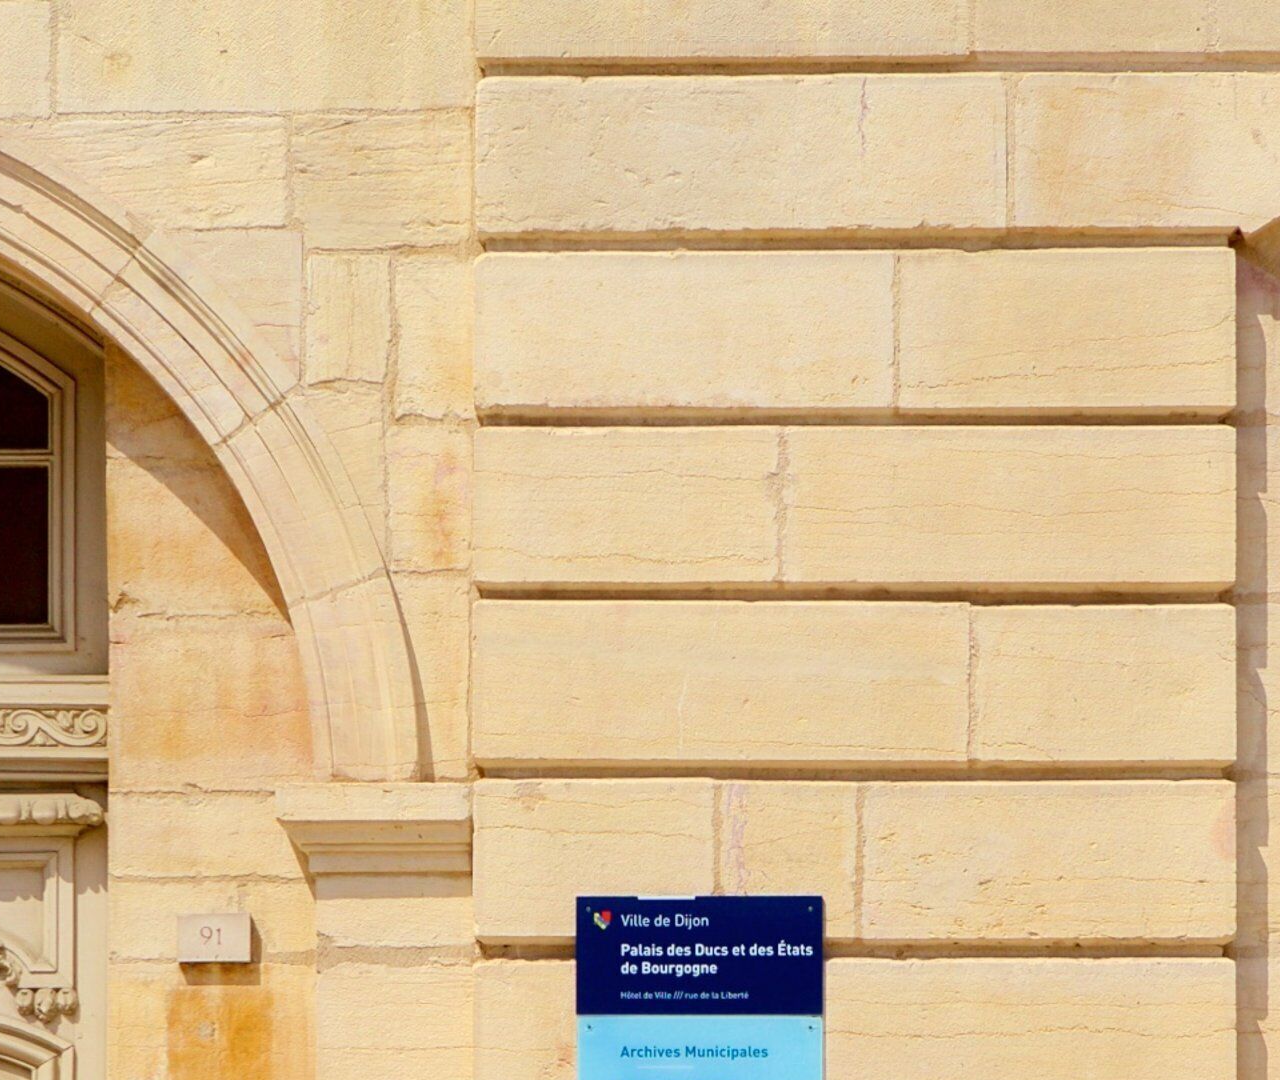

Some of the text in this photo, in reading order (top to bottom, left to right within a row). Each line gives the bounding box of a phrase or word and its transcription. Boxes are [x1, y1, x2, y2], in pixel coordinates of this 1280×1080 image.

[621, 914, 709, 930] Ville de Dijon
[200, 926, 222, 946] 91
[621, 940, 813, 956] Palais des Ducs et des États
[621, 962, 718, 977] de Bourgogne
[643, 991, 653, 1000] de
[654, 991, 672, 1000] Ville
[700, 991, 710, 1000] de
[711, 991, 719, 1000] la
[720, 991, 749, 1000] Liberté
[620, 1046, 769, 1060] Archives Municipales
